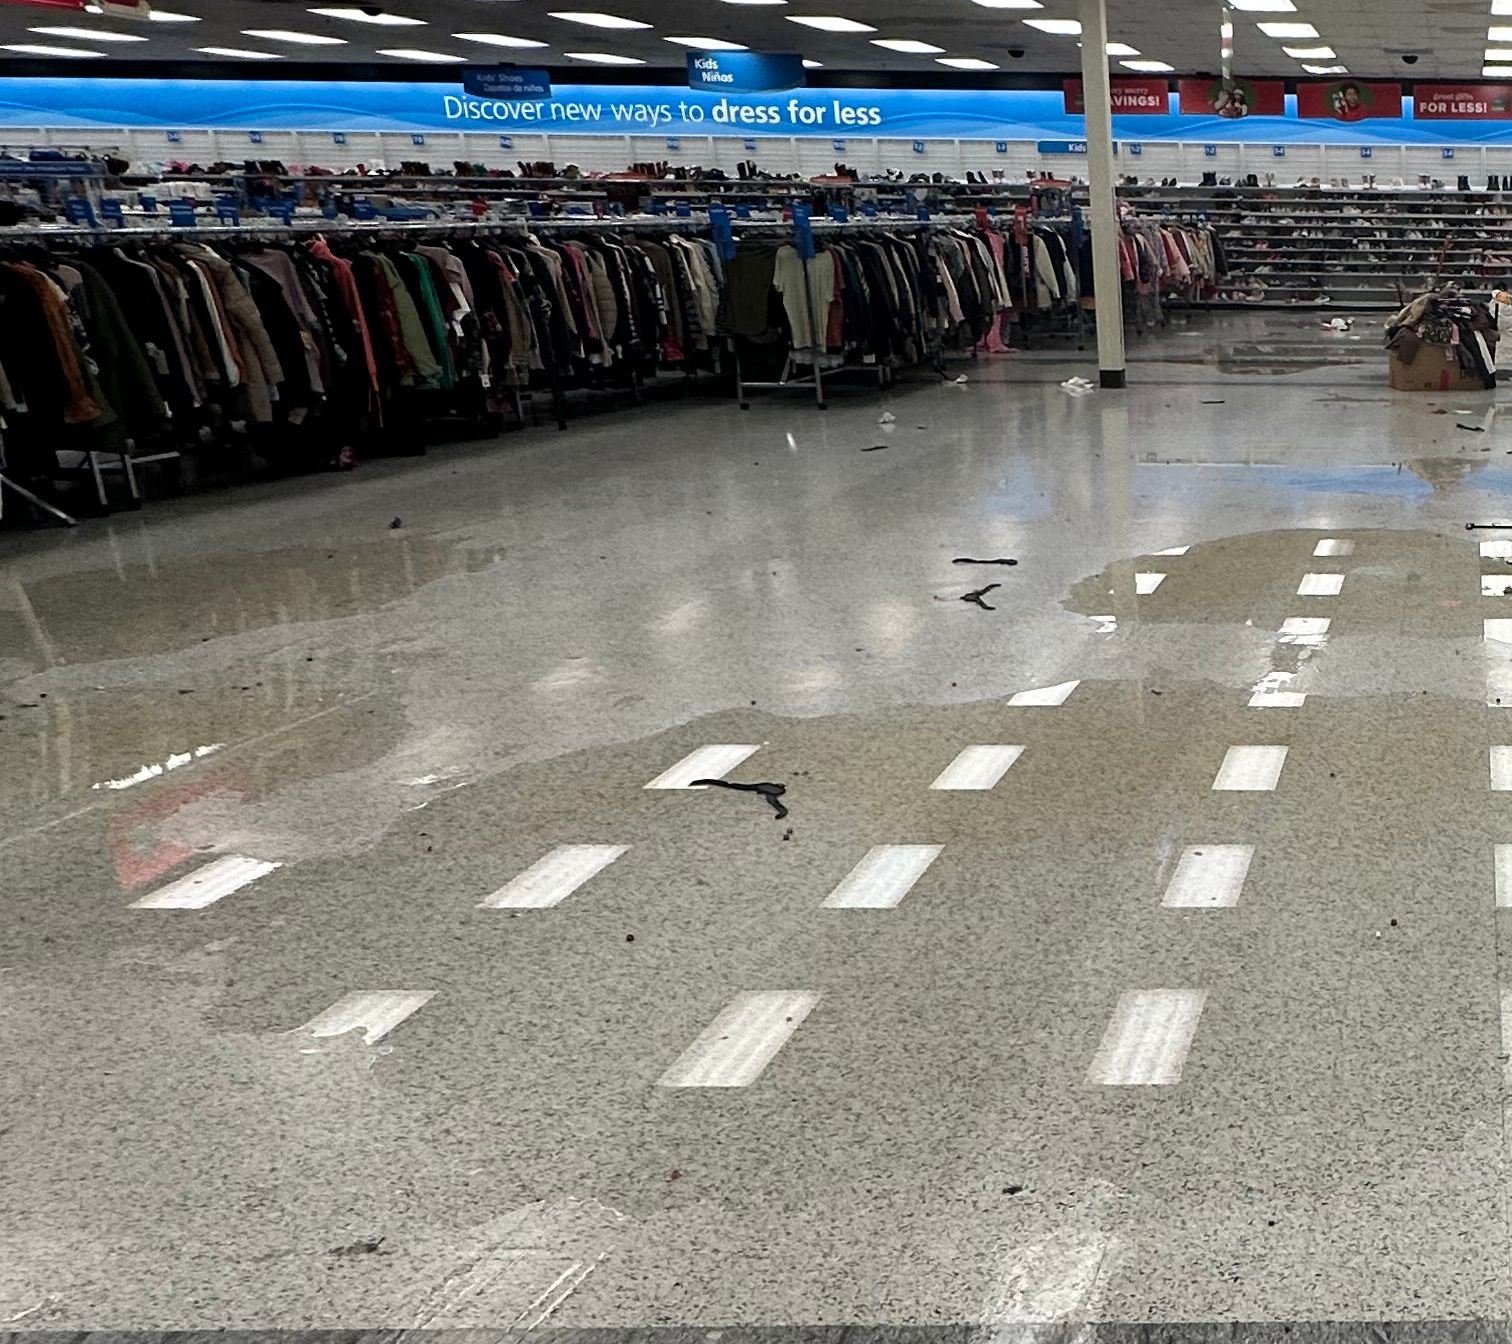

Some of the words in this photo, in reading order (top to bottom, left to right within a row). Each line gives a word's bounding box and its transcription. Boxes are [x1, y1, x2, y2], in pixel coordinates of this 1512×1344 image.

[694, 58, 718, 70] Kids
[701, 71, 733, 83] Niños
[444, 96, 544, 120] Discover
[551, 103, 602, 120] new
[611, 103, 672, 128] ways
[679, 100, 704, 123] to
[712, 99, 781, 124] dress
[787, 99, 827, 124] for
[833, 100, 882, 125] less
[1420, 102, 1447, 113] FOR
[1451, 102, 1488, 113] LESS!
